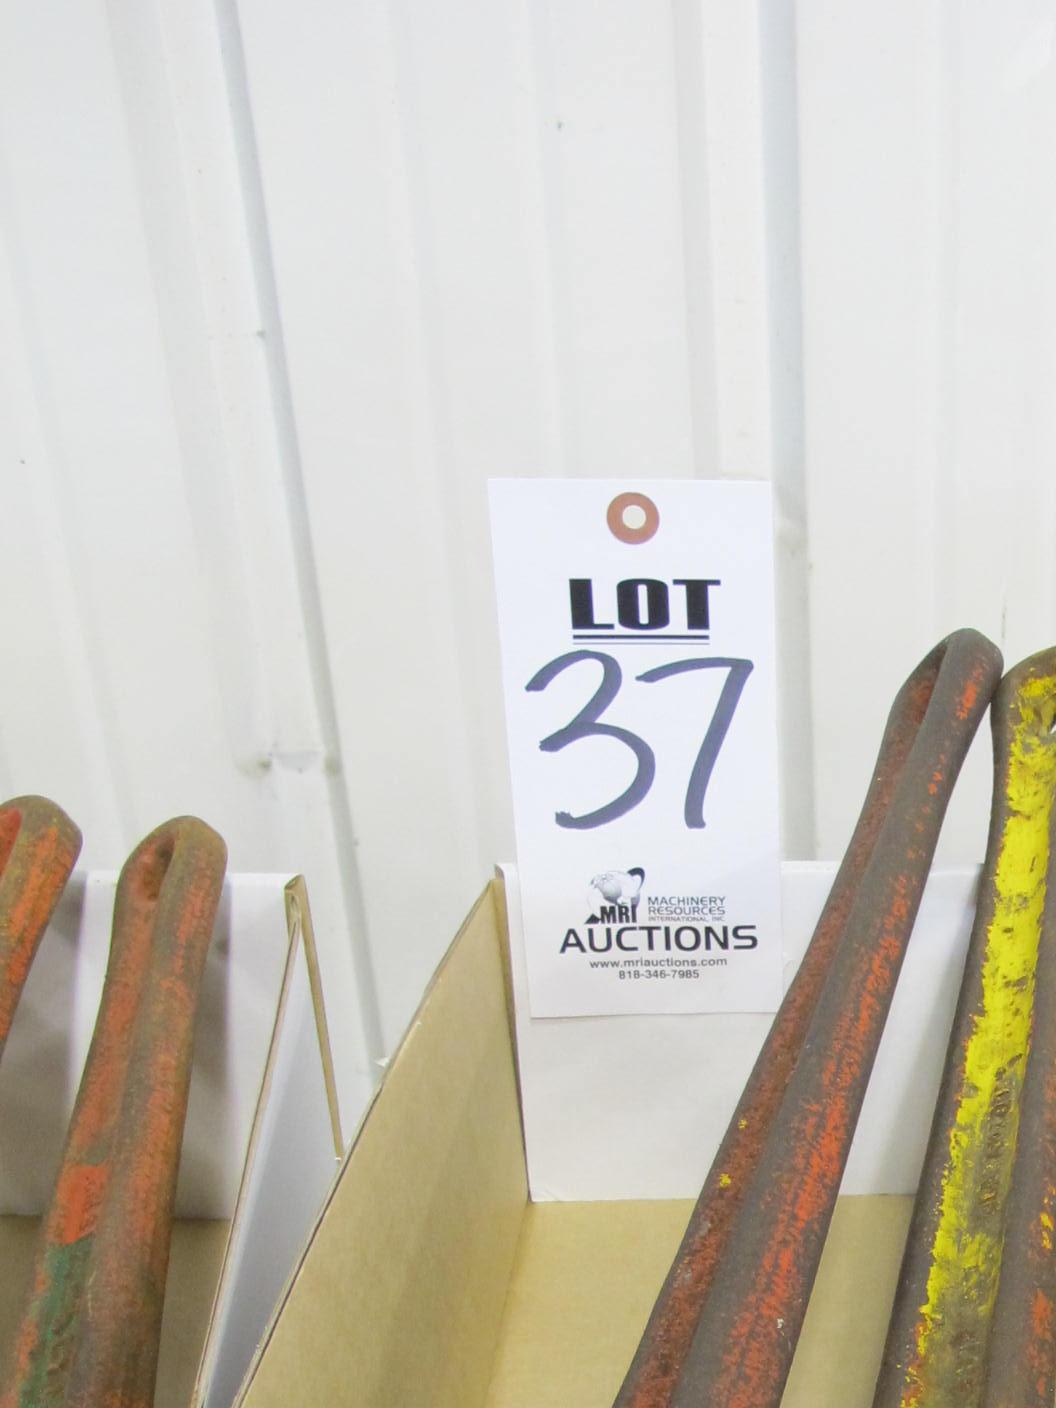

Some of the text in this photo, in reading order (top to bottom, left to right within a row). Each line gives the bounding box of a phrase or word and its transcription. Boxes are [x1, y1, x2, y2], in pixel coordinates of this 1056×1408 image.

[569, 578, 721, 631] LOT
[525, 649, 754, 830] 37
[647, 896, 727, 906] MACHINERY
[599, 904, 638, 925] MRI
[647, 906, 727, 916] RESOURCES
[559, 925, 758, 954] AUCTIONS
[589, 957, 728, 969] www.mriauctions.com
[618, 969, 700, 980] 818-346-7985
